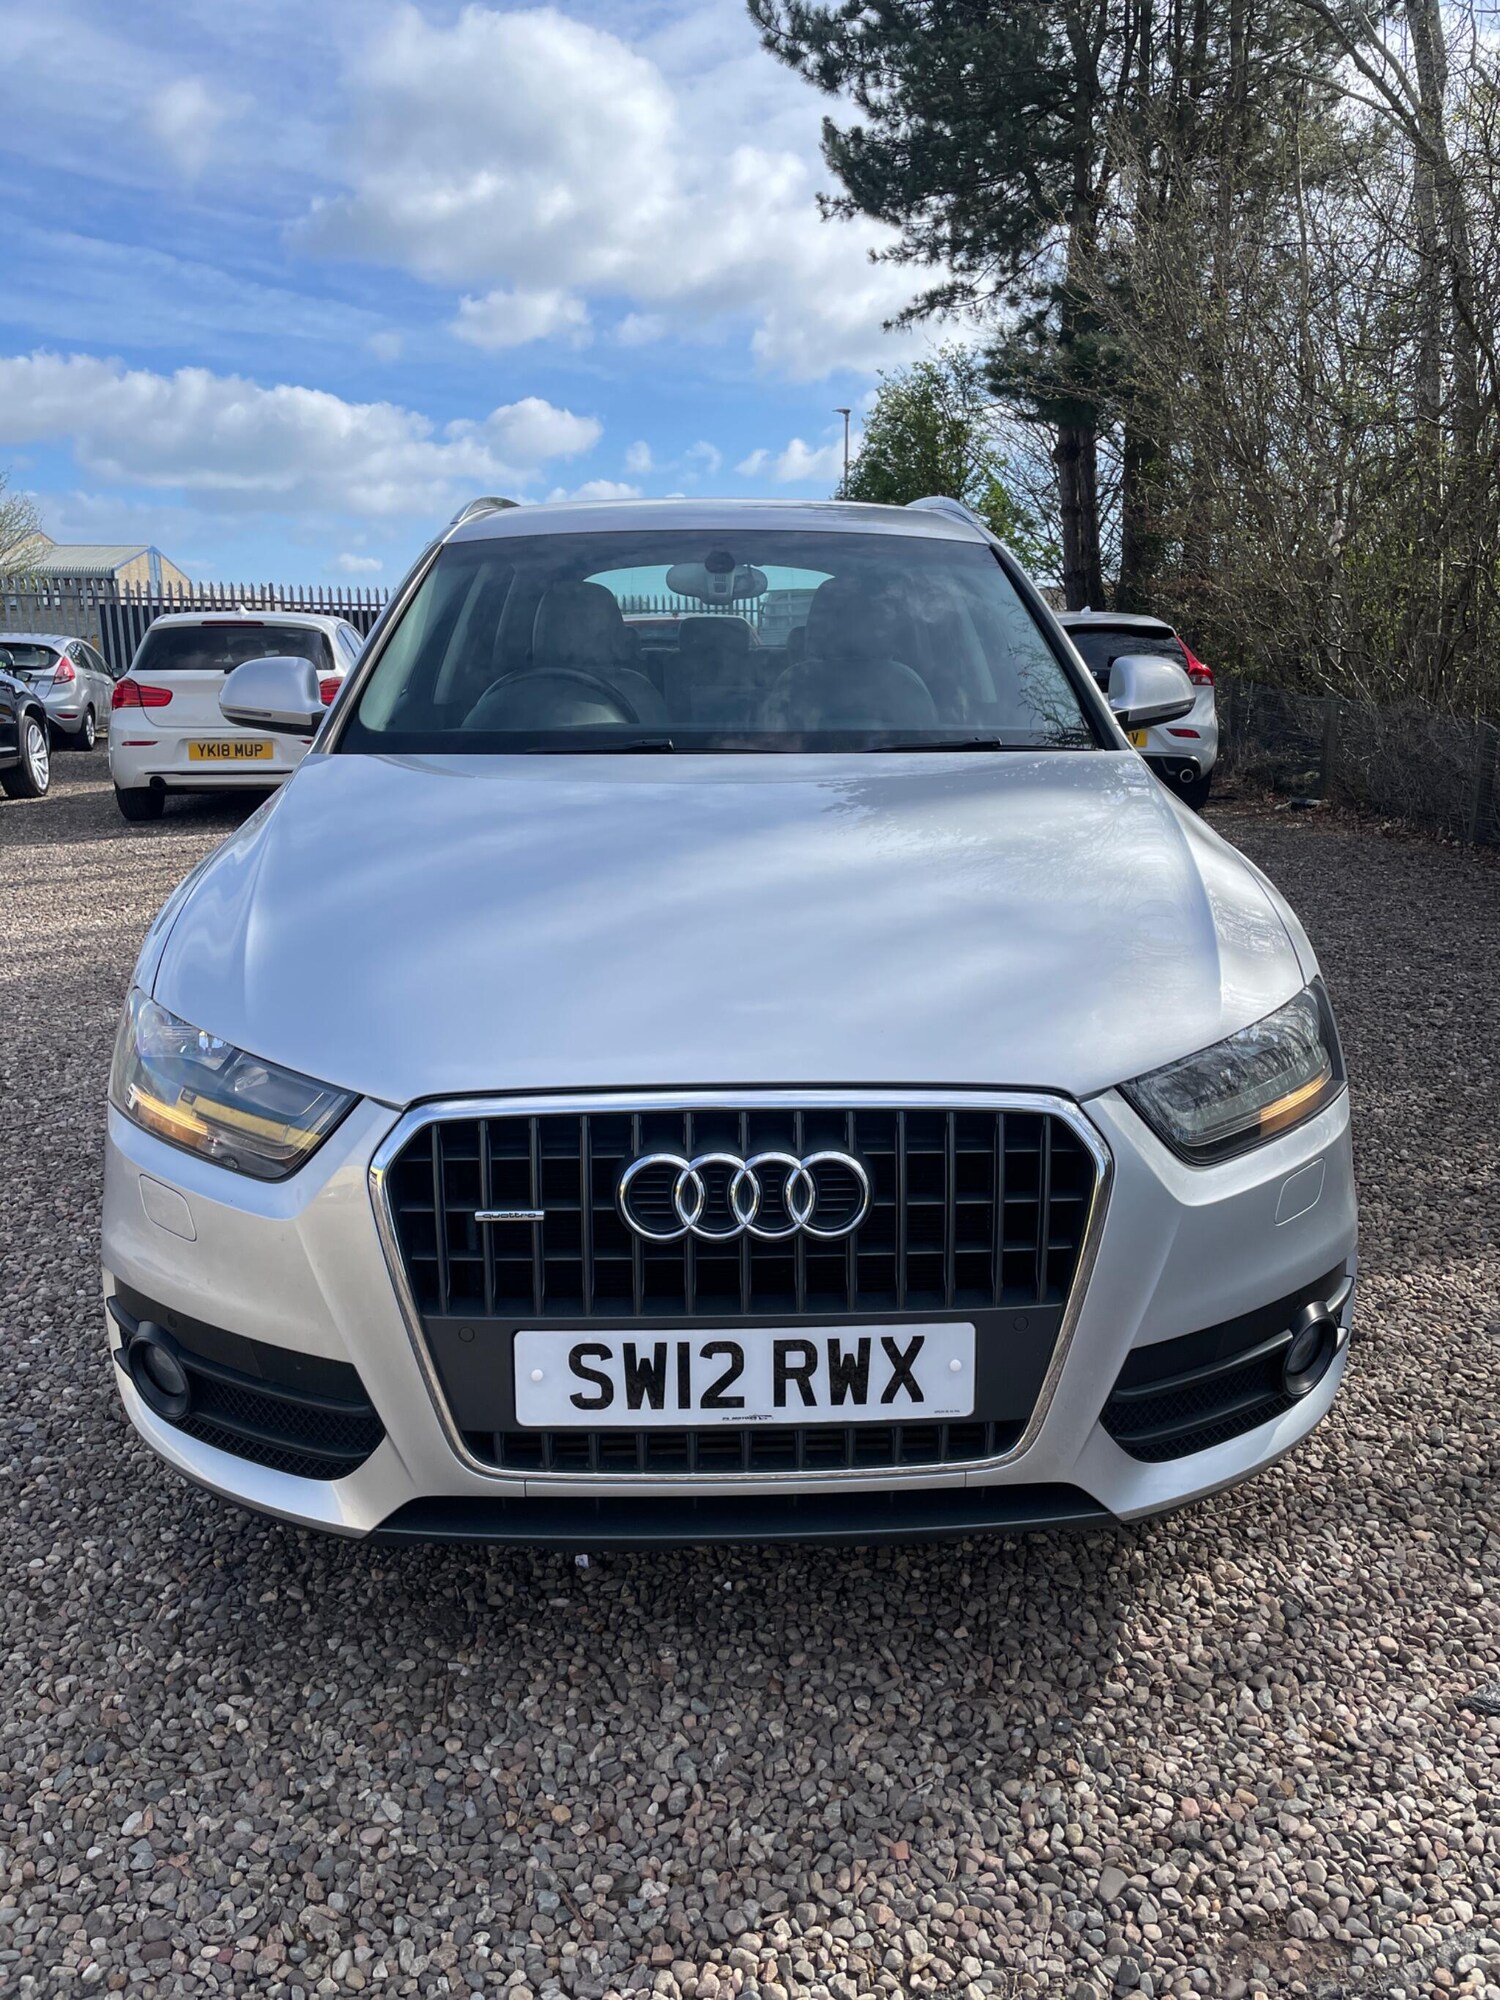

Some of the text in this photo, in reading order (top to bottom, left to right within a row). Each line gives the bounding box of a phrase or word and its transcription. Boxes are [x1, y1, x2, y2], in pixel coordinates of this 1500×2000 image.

[197, 743, 263, 757] YK18 MUP
[482, 1211, 537, 1220] quattro
[569, 1335, 925, 1410] SW12 RWX
